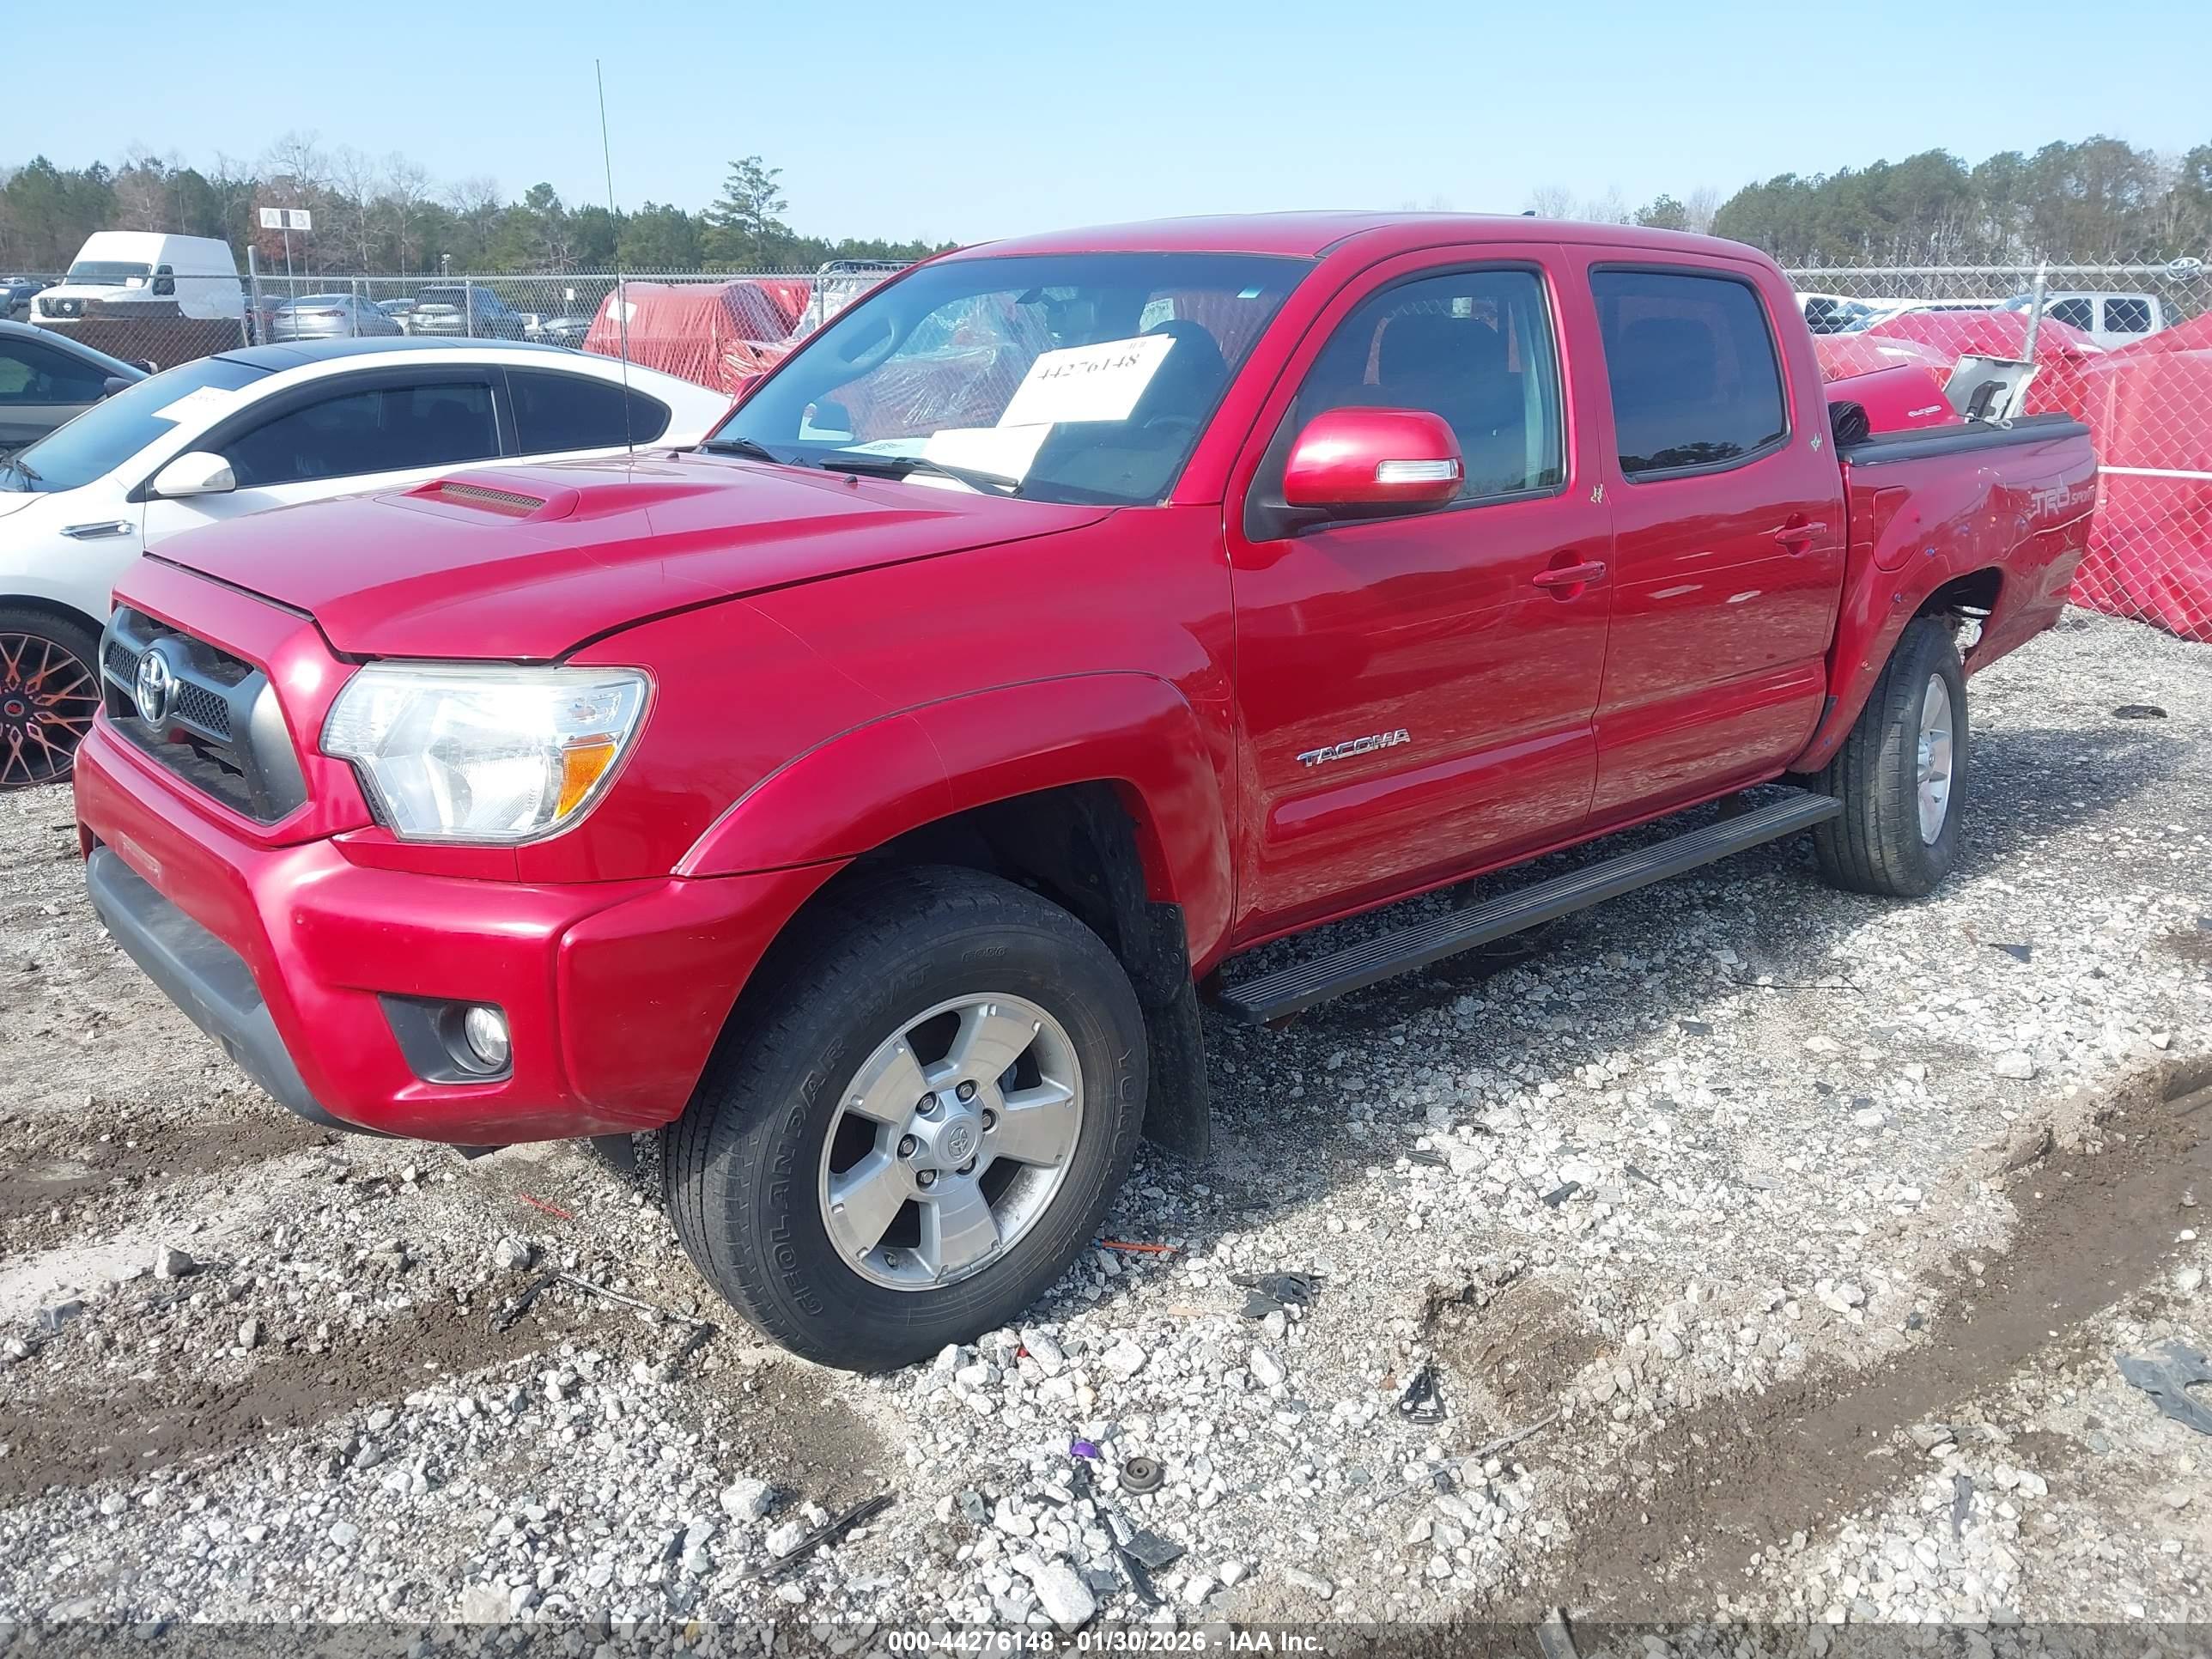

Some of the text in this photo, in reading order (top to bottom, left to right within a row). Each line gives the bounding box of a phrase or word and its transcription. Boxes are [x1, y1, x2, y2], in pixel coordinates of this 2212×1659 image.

[263, 210, 307, 227] A B
[1037, 353, 1140, 380] 44276148
[2031, 486, 2070, 519] TRD
[1296, 728, 1411, 768] TACOMA
